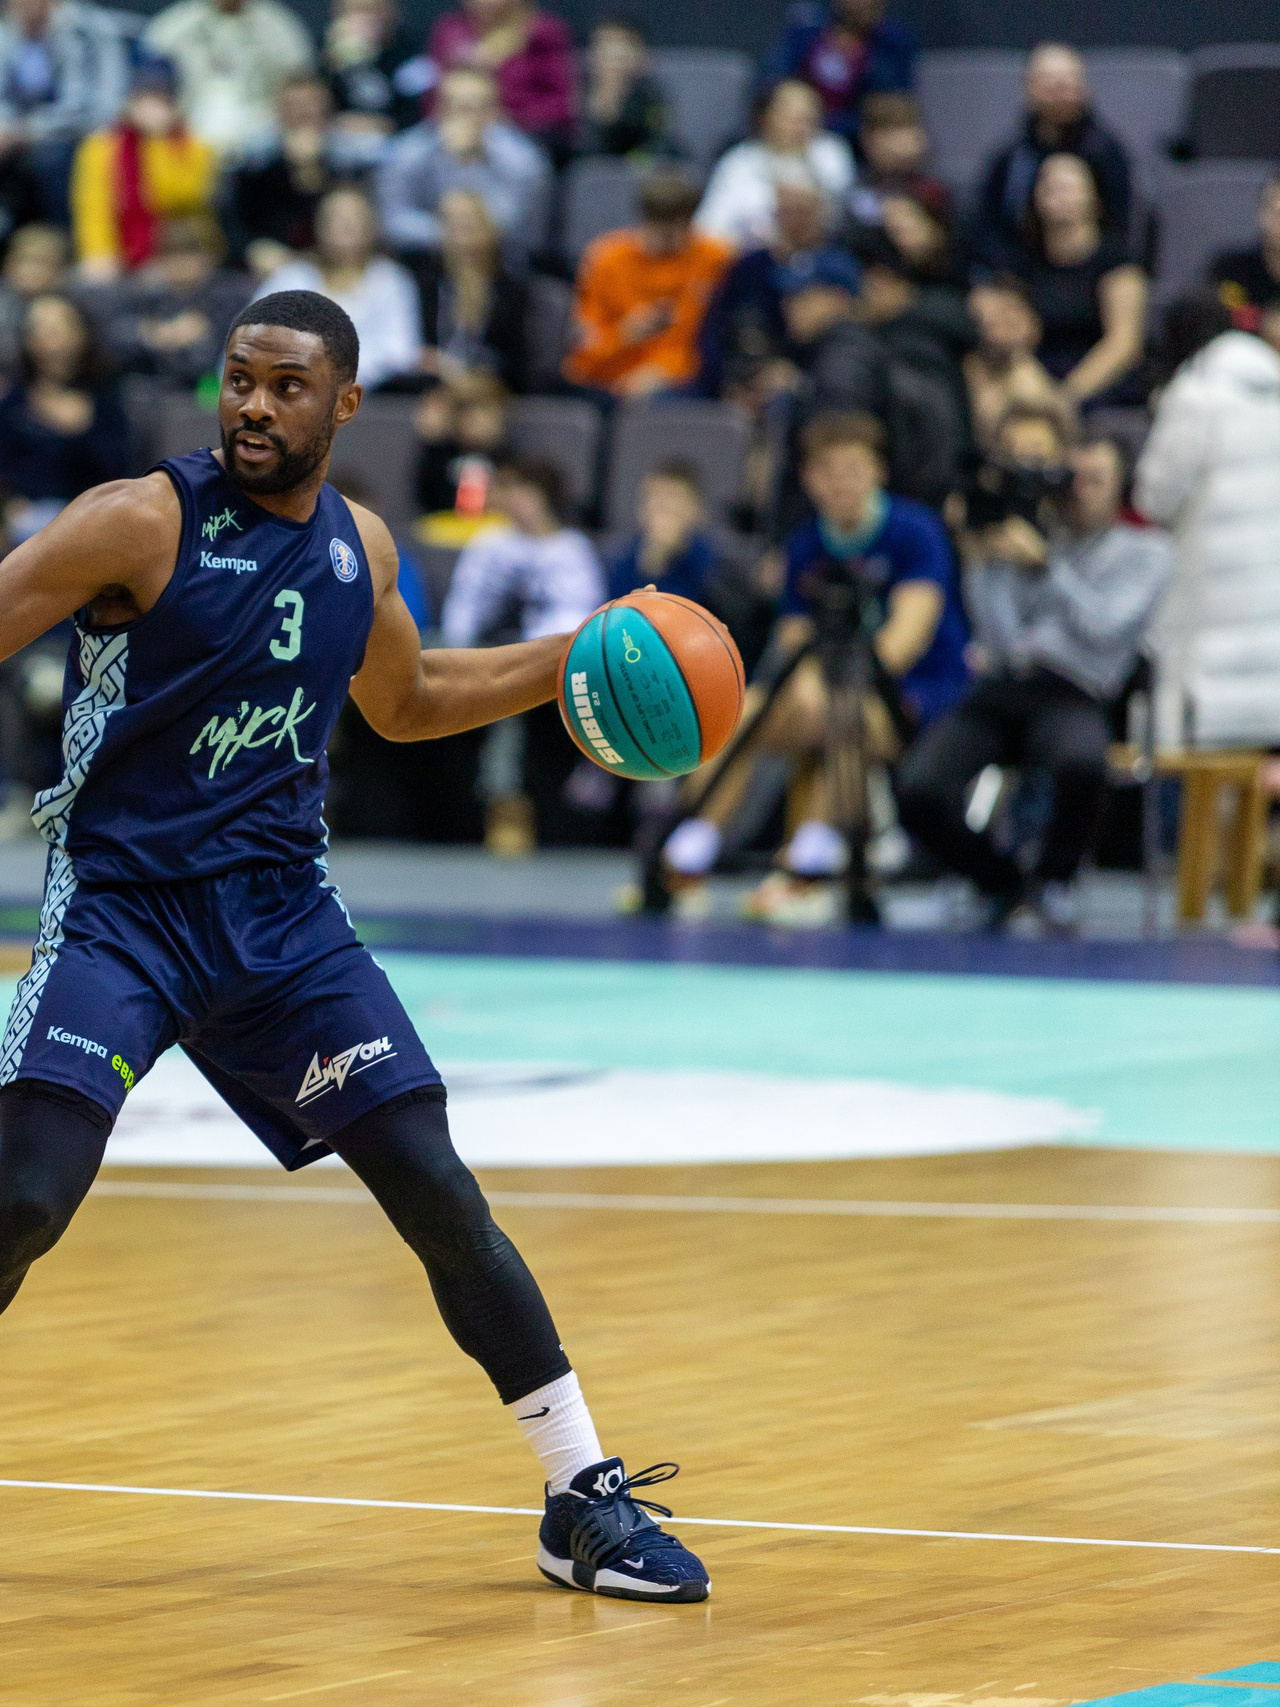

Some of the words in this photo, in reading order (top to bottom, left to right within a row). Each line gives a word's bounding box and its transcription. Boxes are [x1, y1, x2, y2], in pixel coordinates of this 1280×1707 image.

[200, 551, 258, 575] Kempa
[269, 589, 304, 661] 3
[571, 671, 624, 764] SIBUR
[46, 1026, 109, 1059] Kempa
[111, 1054, 135, 1093] евр
